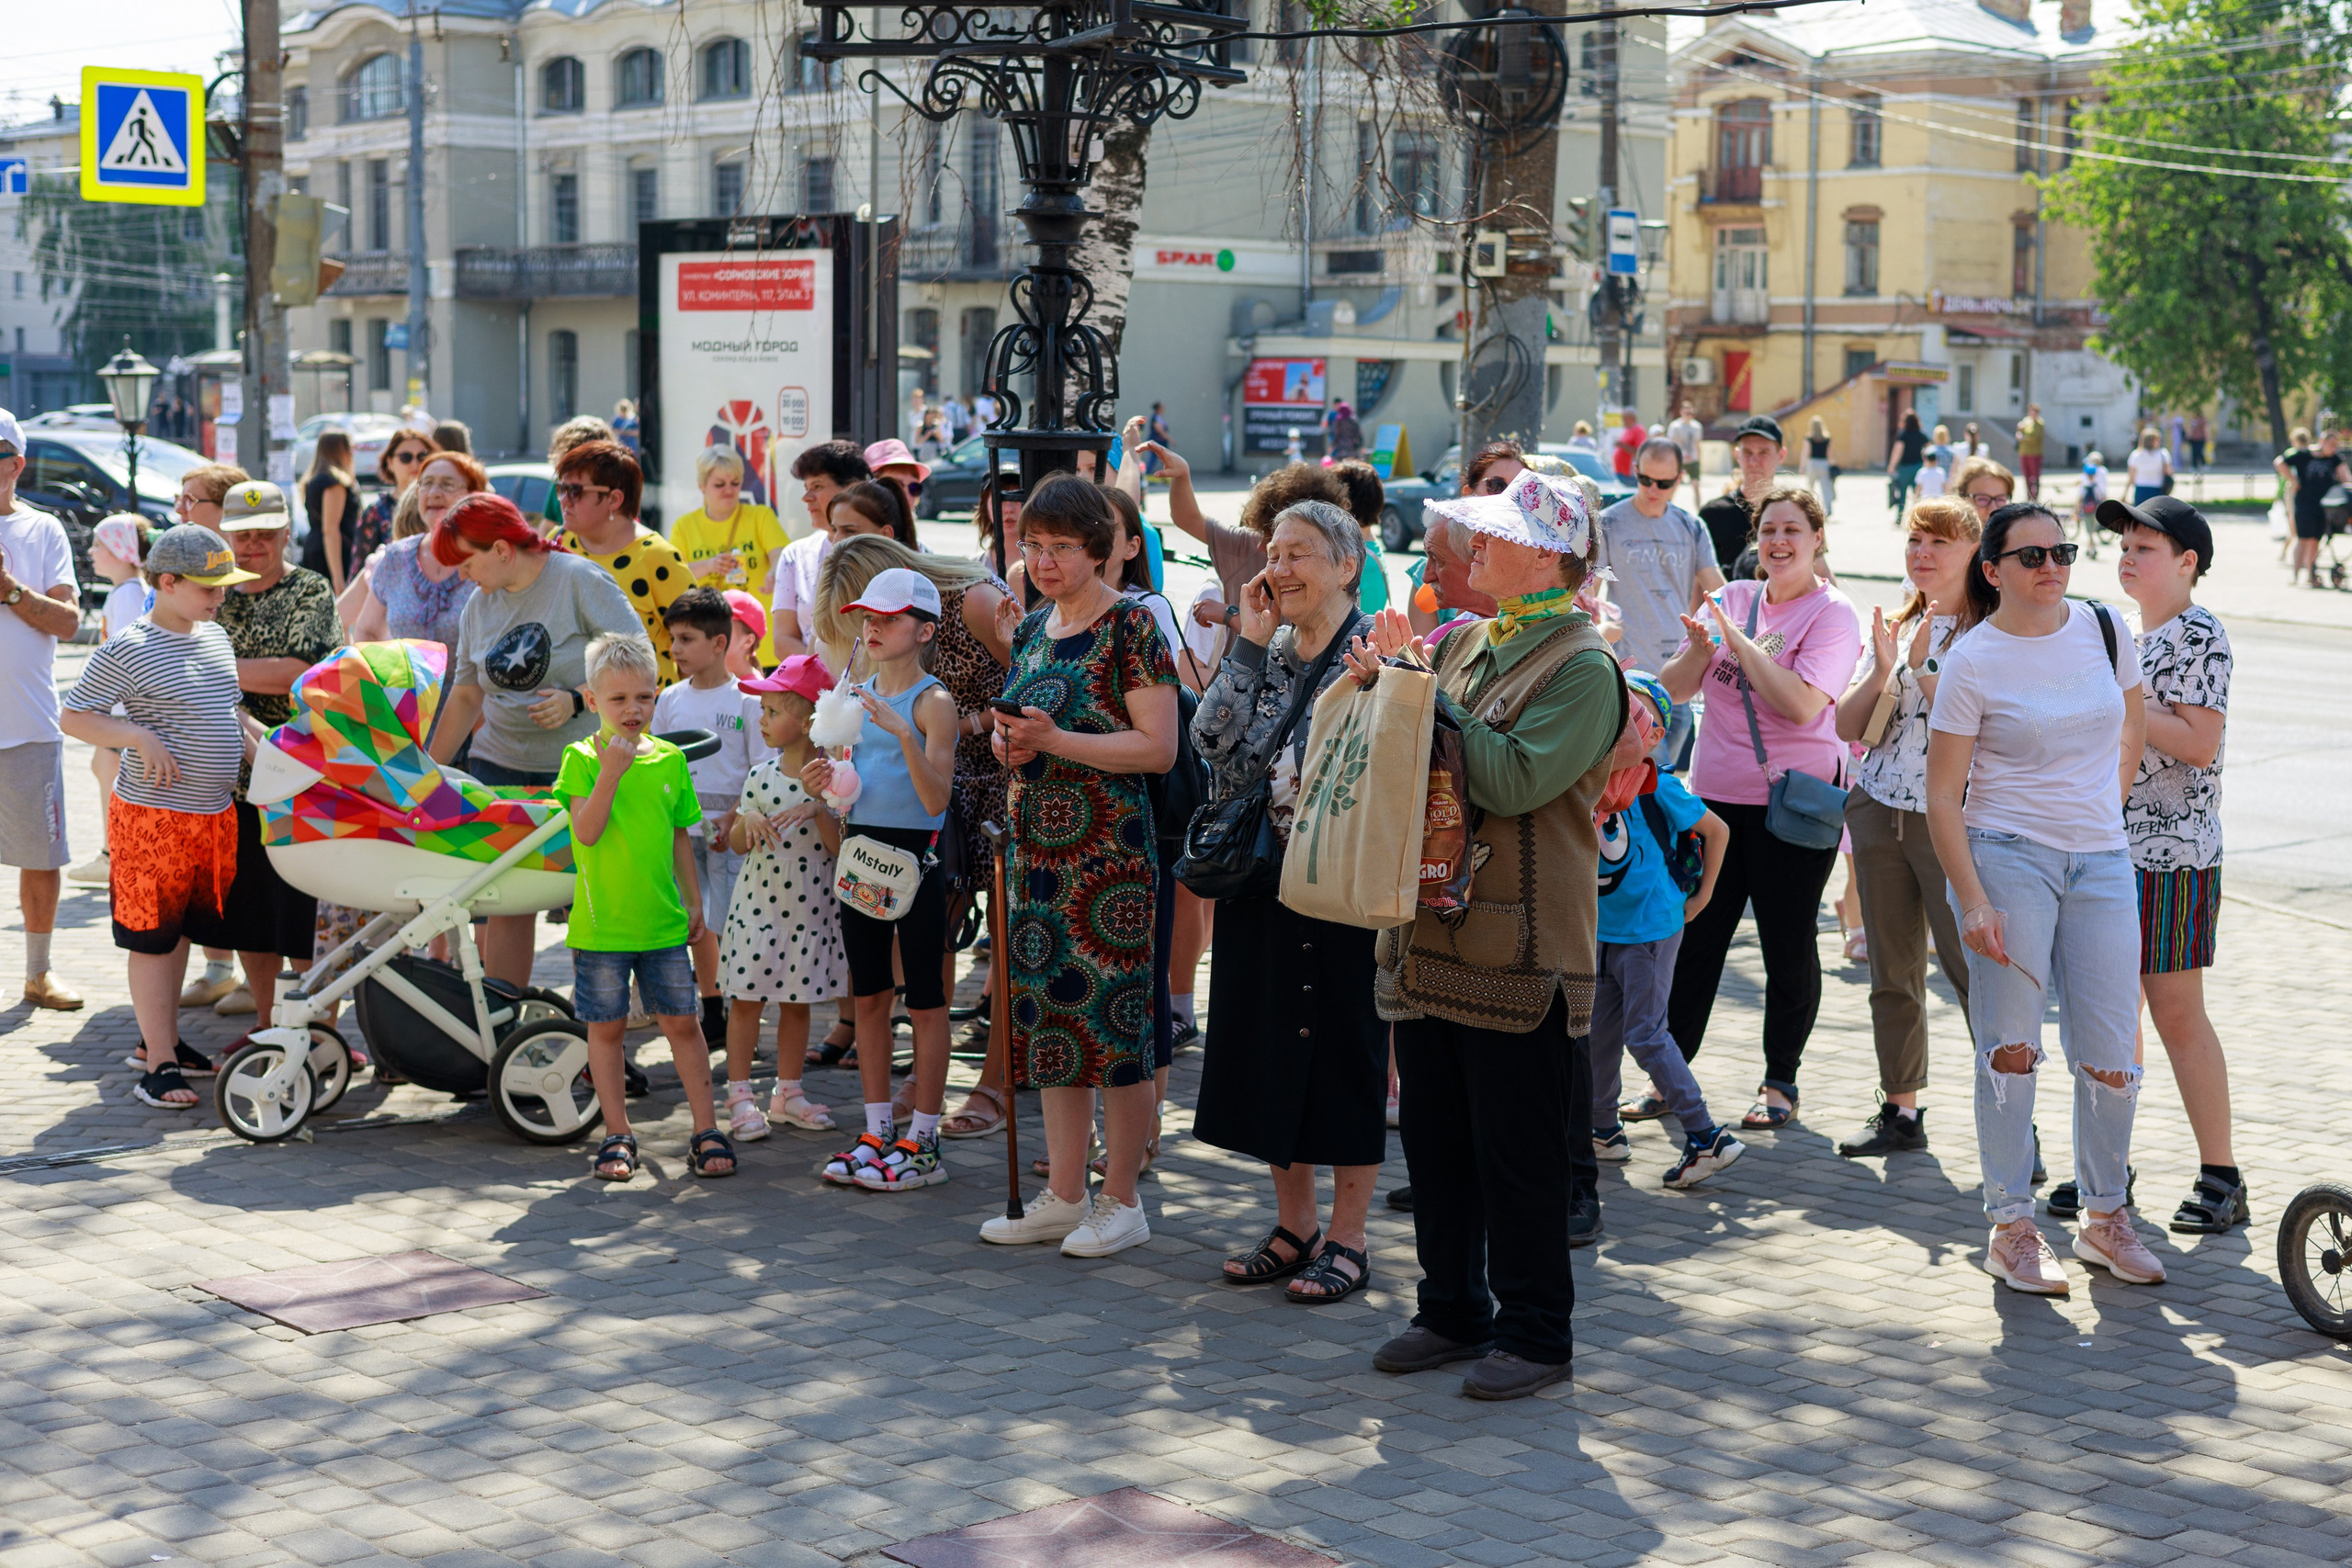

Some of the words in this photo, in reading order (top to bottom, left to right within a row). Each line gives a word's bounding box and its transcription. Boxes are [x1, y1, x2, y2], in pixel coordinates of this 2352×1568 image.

[1156, 251, 1215, 265] SPAR
[682, 290, 696, 301] УЛ.
[699, 290, 760, 302] КОМИНТЕРНА,
[776, 289, 801, 301] ЭТАЖ
[804, 289, 810, 300] 3
[692, 340, 752, 353] МОДНЫЙ
[755, 341, 798, 353] ГОРОД
[494, 671, 511, 685] NEW
[514, 663, 541, 685] FASHION
[1713, 668, 1733, 686] FOR
[2129, 818, 2179, 836] TERMIT
[1419, 862, 1448, 880] GRO
